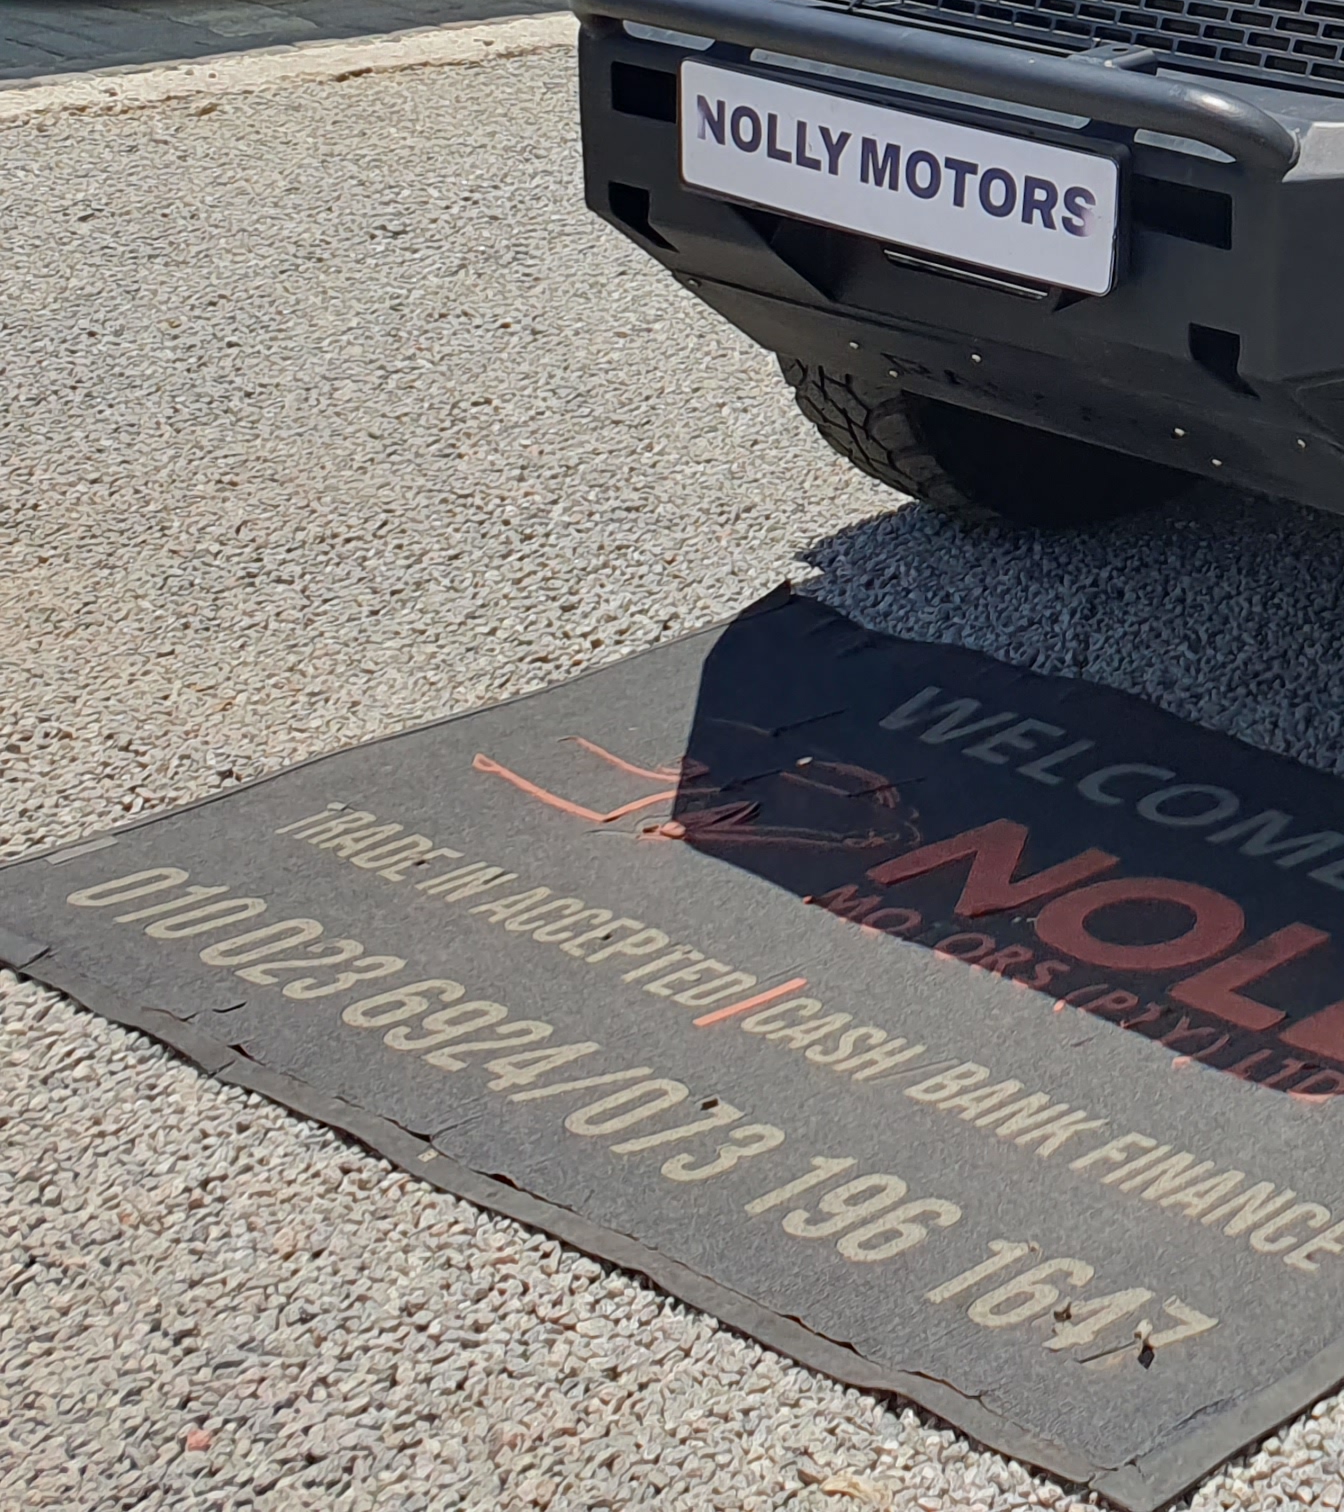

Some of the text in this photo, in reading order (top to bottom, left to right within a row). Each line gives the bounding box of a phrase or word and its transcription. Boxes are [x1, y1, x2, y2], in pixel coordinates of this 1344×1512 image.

[696, 94, 1097, 238] NOLLY MOTORS
[274, 801, 465, 882] TRADE
[415, 861, 520, 903] IN
[806, 884, 1071, 991] MOORS
[66, 866, 268, 939] 010
[199, 917, 407, 1000] 023
[743, 1155, 963, 1262] 196
